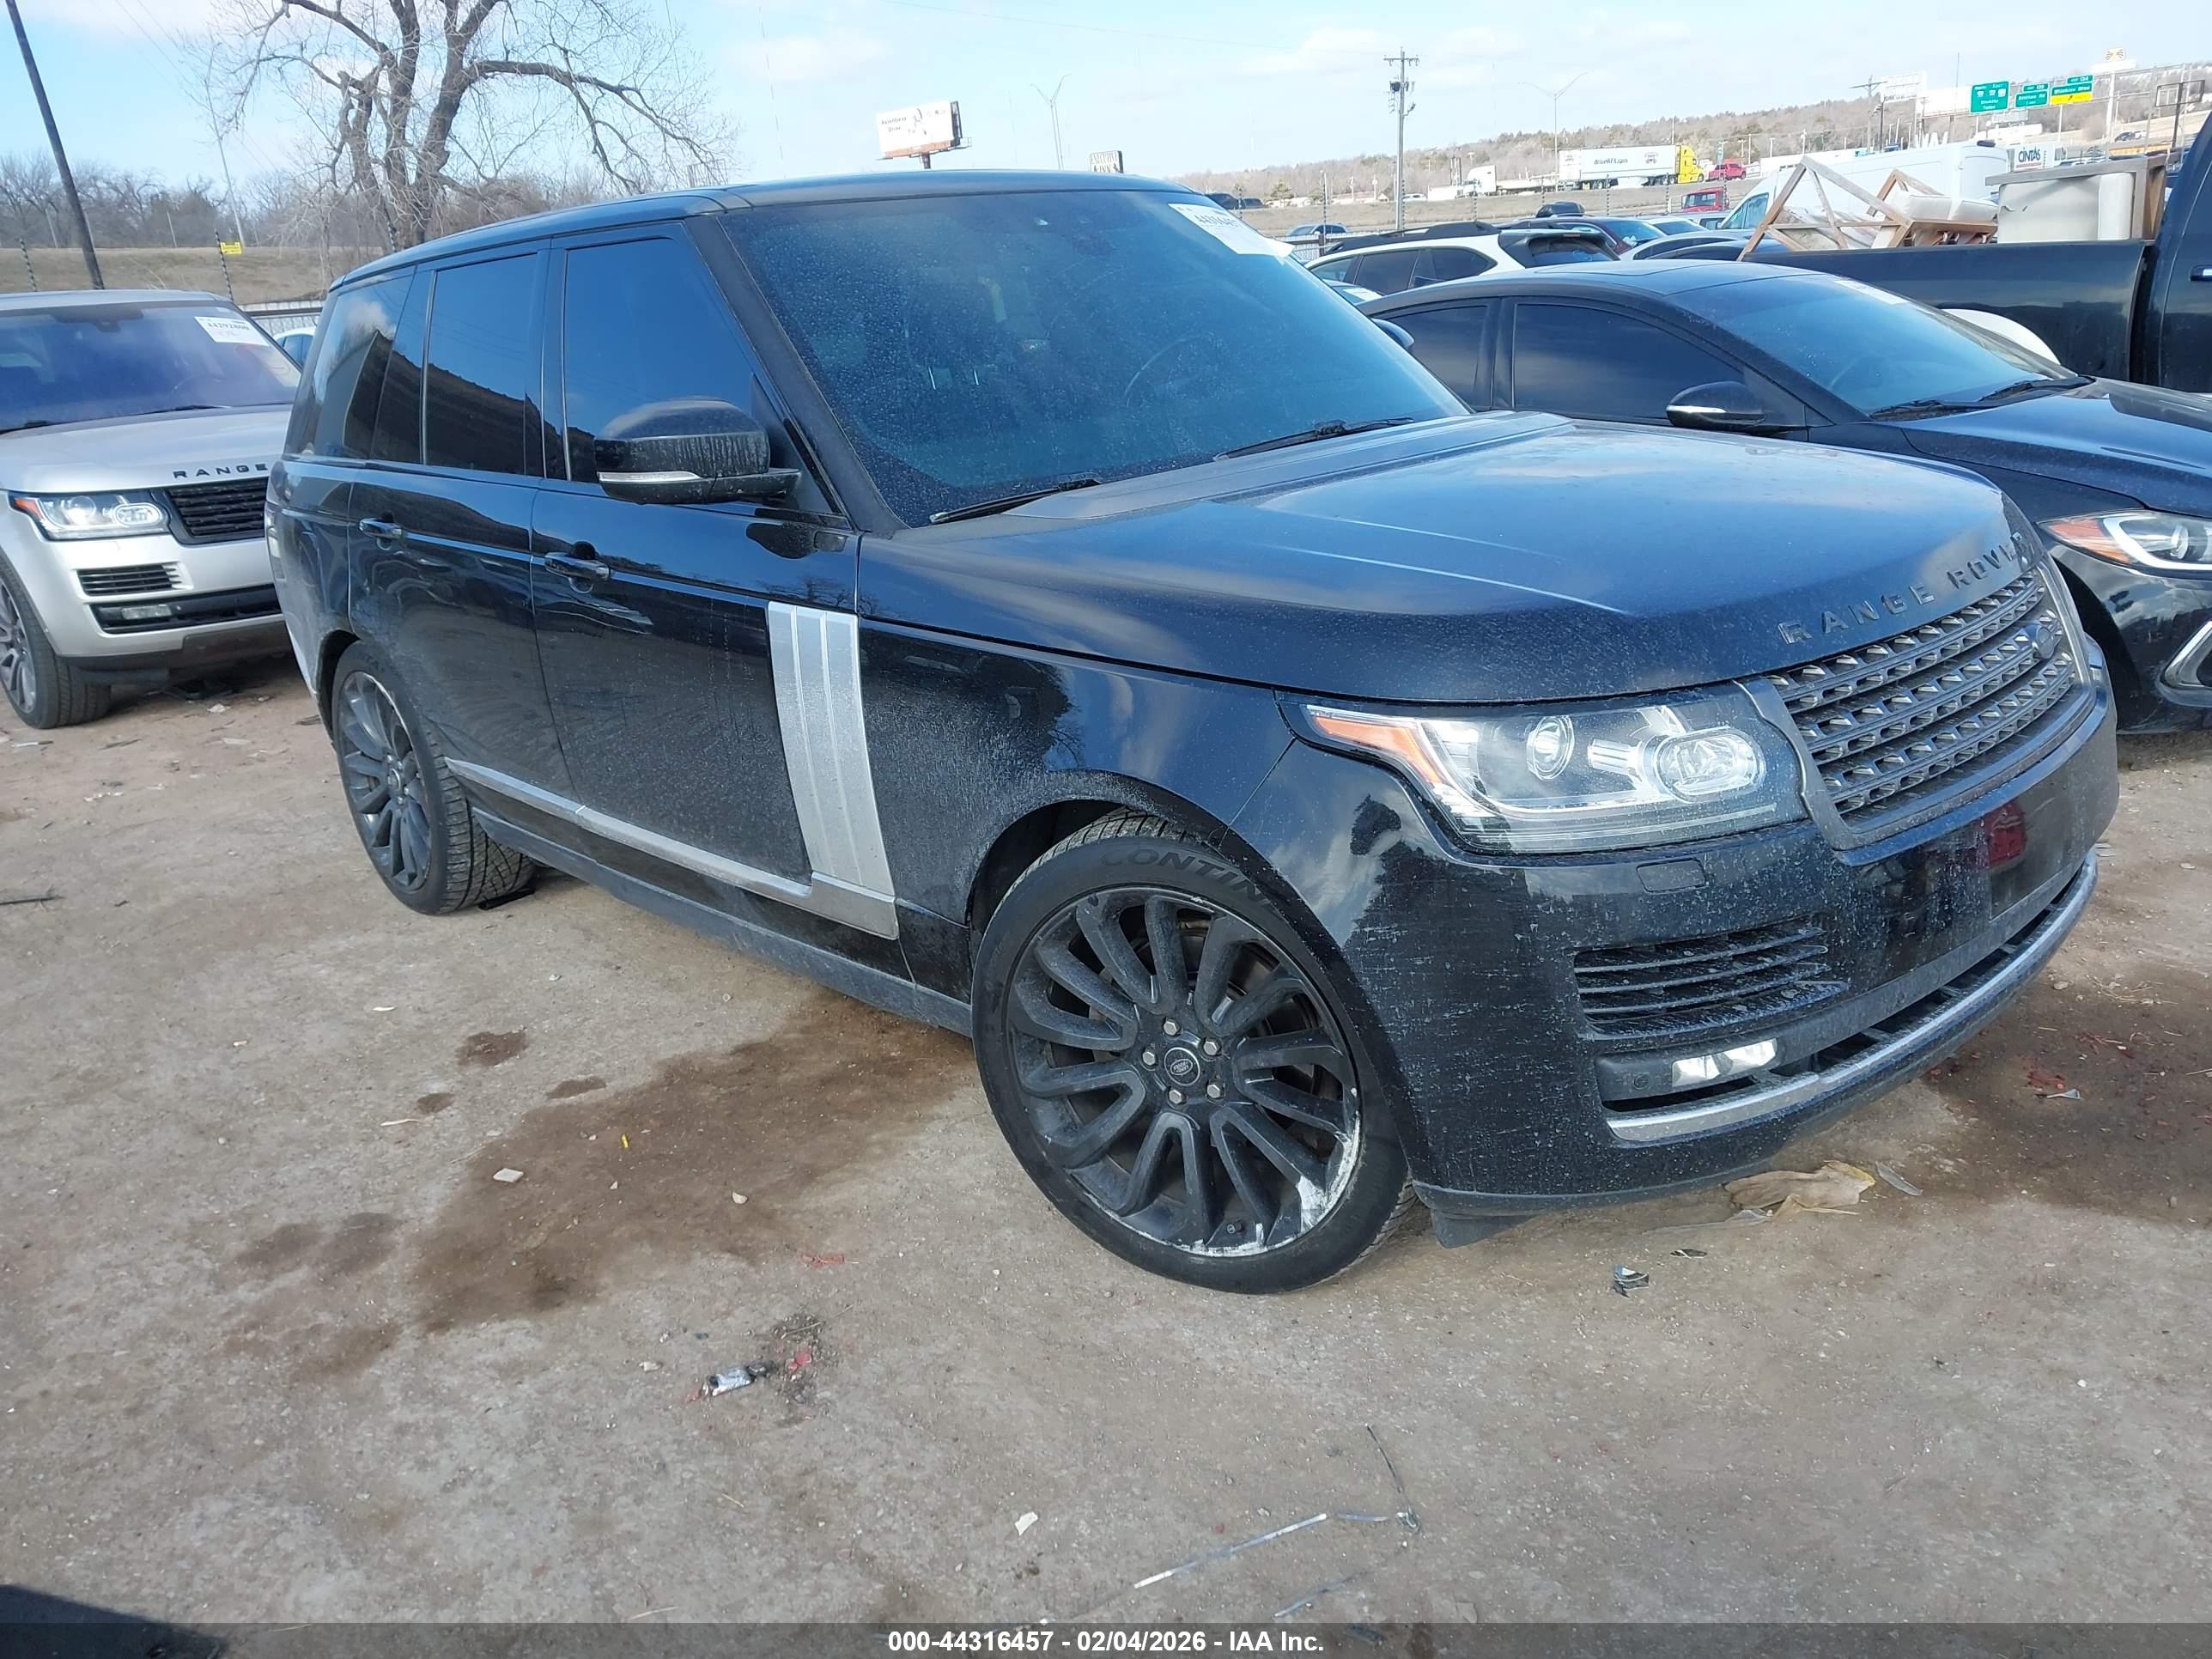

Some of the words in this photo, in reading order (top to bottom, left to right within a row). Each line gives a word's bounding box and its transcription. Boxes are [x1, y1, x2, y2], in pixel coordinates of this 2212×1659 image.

[2018, 146, 2041, 163] CINTAS
[173, 463, 269, 479] RANGE
[1778, 582, 1936, 645] RANGE
